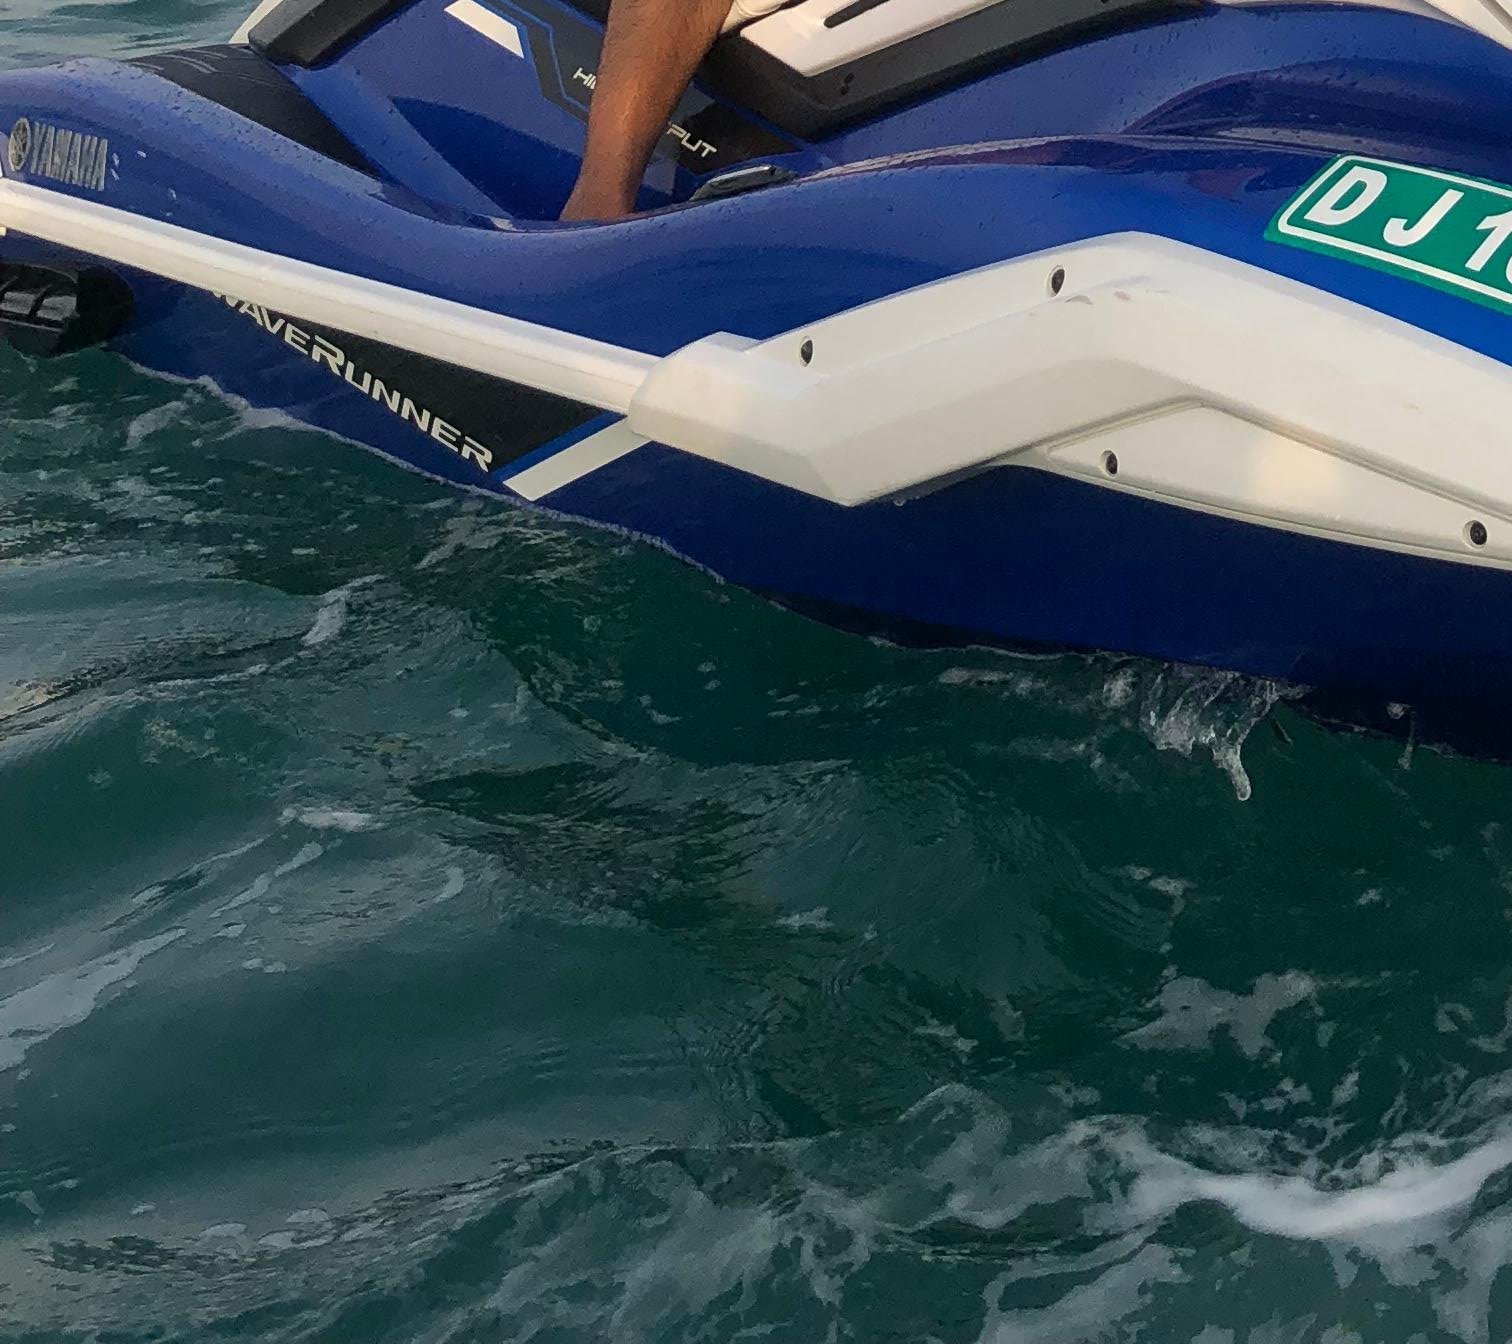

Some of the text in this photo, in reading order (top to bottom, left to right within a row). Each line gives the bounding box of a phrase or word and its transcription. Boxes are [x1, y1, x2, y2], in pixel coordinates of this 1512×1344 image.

[667, 121, 717, 158] PUT
[1304, 166, 1387, 226] D
[1383, 189, 1464, 247] J
